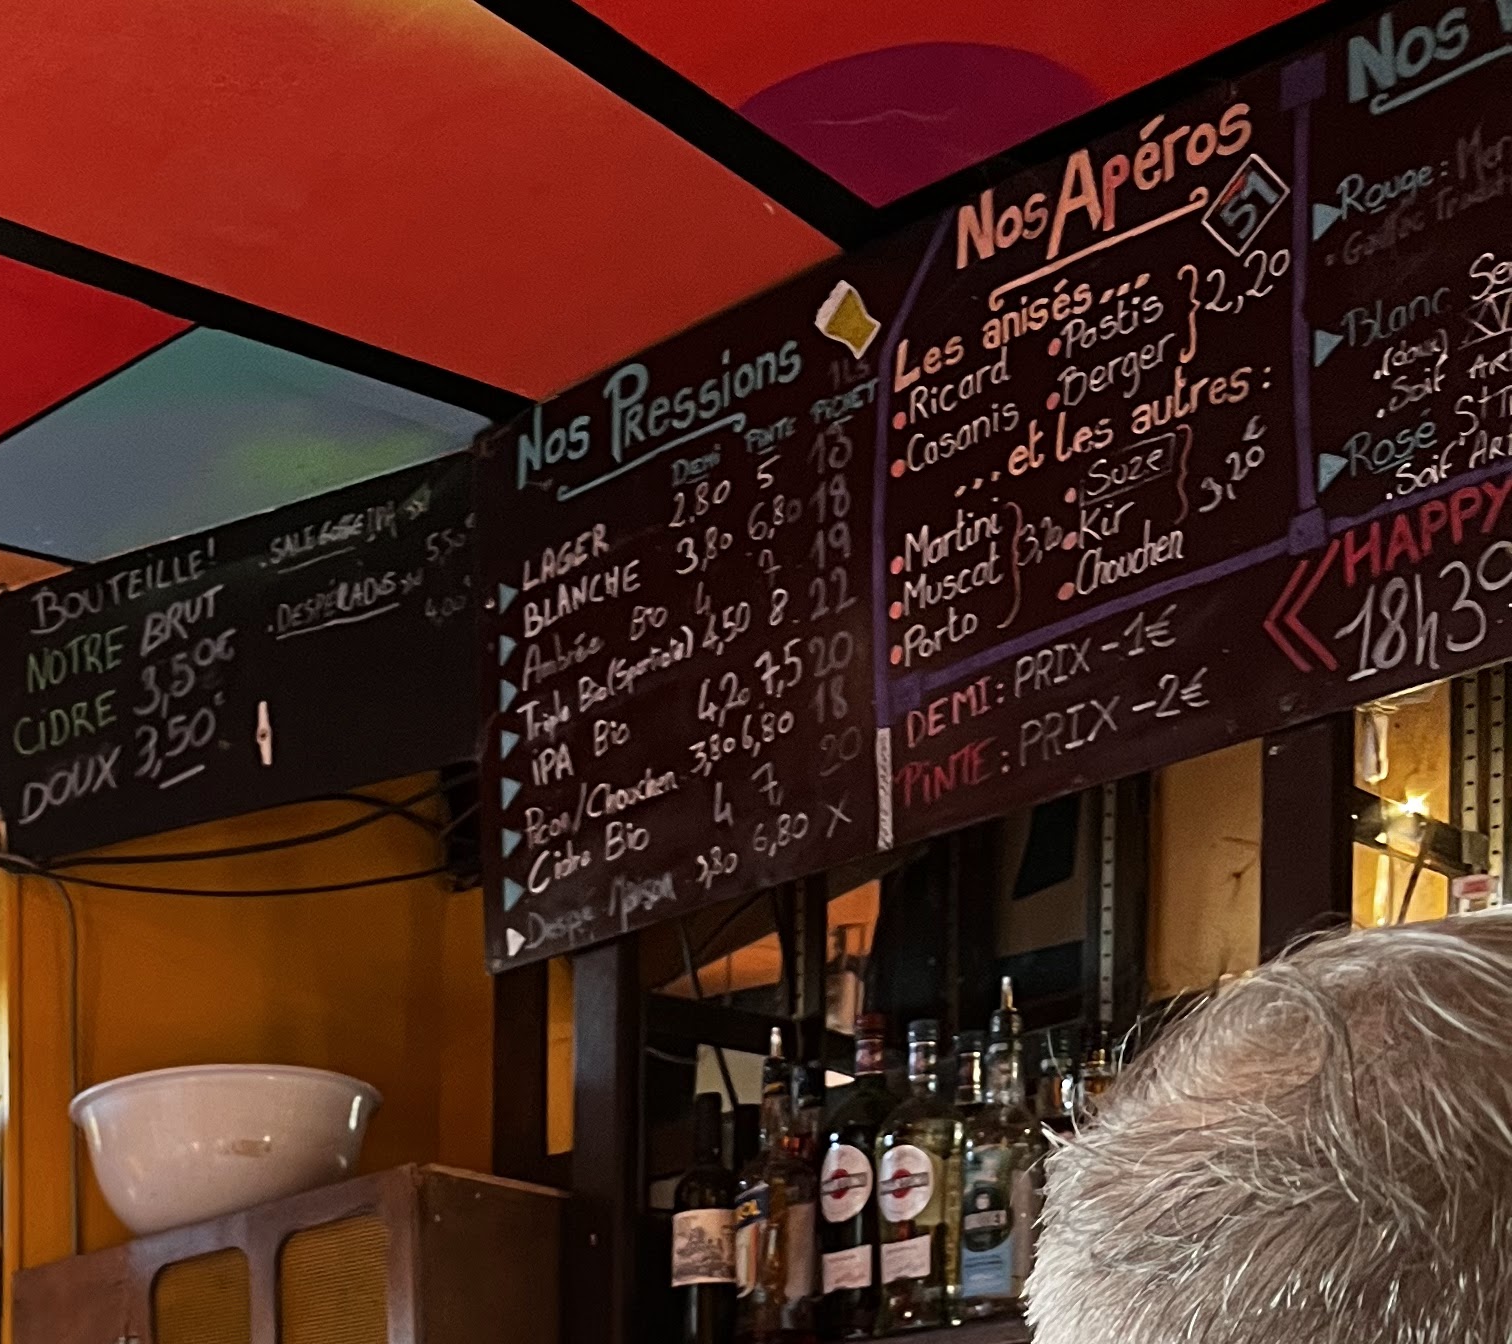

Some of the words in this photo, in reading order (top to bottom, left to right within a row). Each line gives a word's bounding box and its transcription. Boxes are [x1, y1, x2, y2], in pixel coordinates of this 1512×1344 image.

[1347, 6, 1471, 104] Nos
[955, 187, 1049, 270] Nos
[1045, 101, 1253, 261] Apéros
[1203, 248, 1291, 314] 2,20
[1341, 286, 1451, 348] Blanc
[893, 335, 965, 394] Les
[908, 346, 1013, 425] Ricard
[1055, 331, 1179, 407] Berger
[516, 402, 592, 490] Nos
[903, 400, 1021, 474] Casanis
[1054, 410, 1116, 463] les
[1085, 447, 1165, 497] Suze
[521, 522, 611, 592] LAGER
[756, 454, 782, 490] 5
[809, 519, 853, 570] 19
[903, 495, 1004, 573] Martini
[1078, 500, 1136, 550] Kir
[1342, 478, 1512, 588] HAPPY
[522, 559, 641, 639] BLANCHE
[674, 525, 734, 576] 3,80
[747, 493, 804, 542] 6,80
[809, 565, 859, 622] 22
[902, 541, 1005, 616] Muscat
[26, 623, 130, 694] NOTRE
[138, 584, 226, 658] BRUT
[903, 606, 979, 668] Porto
[1334, 539, 1512, 683] 18h30
[1013, 638, 1093, 698] PRIX
[1019, 695, 1120, 767] PRIX
[17, 744, 123, 826] DOUX
[604, 820, 652, 862] Bio
